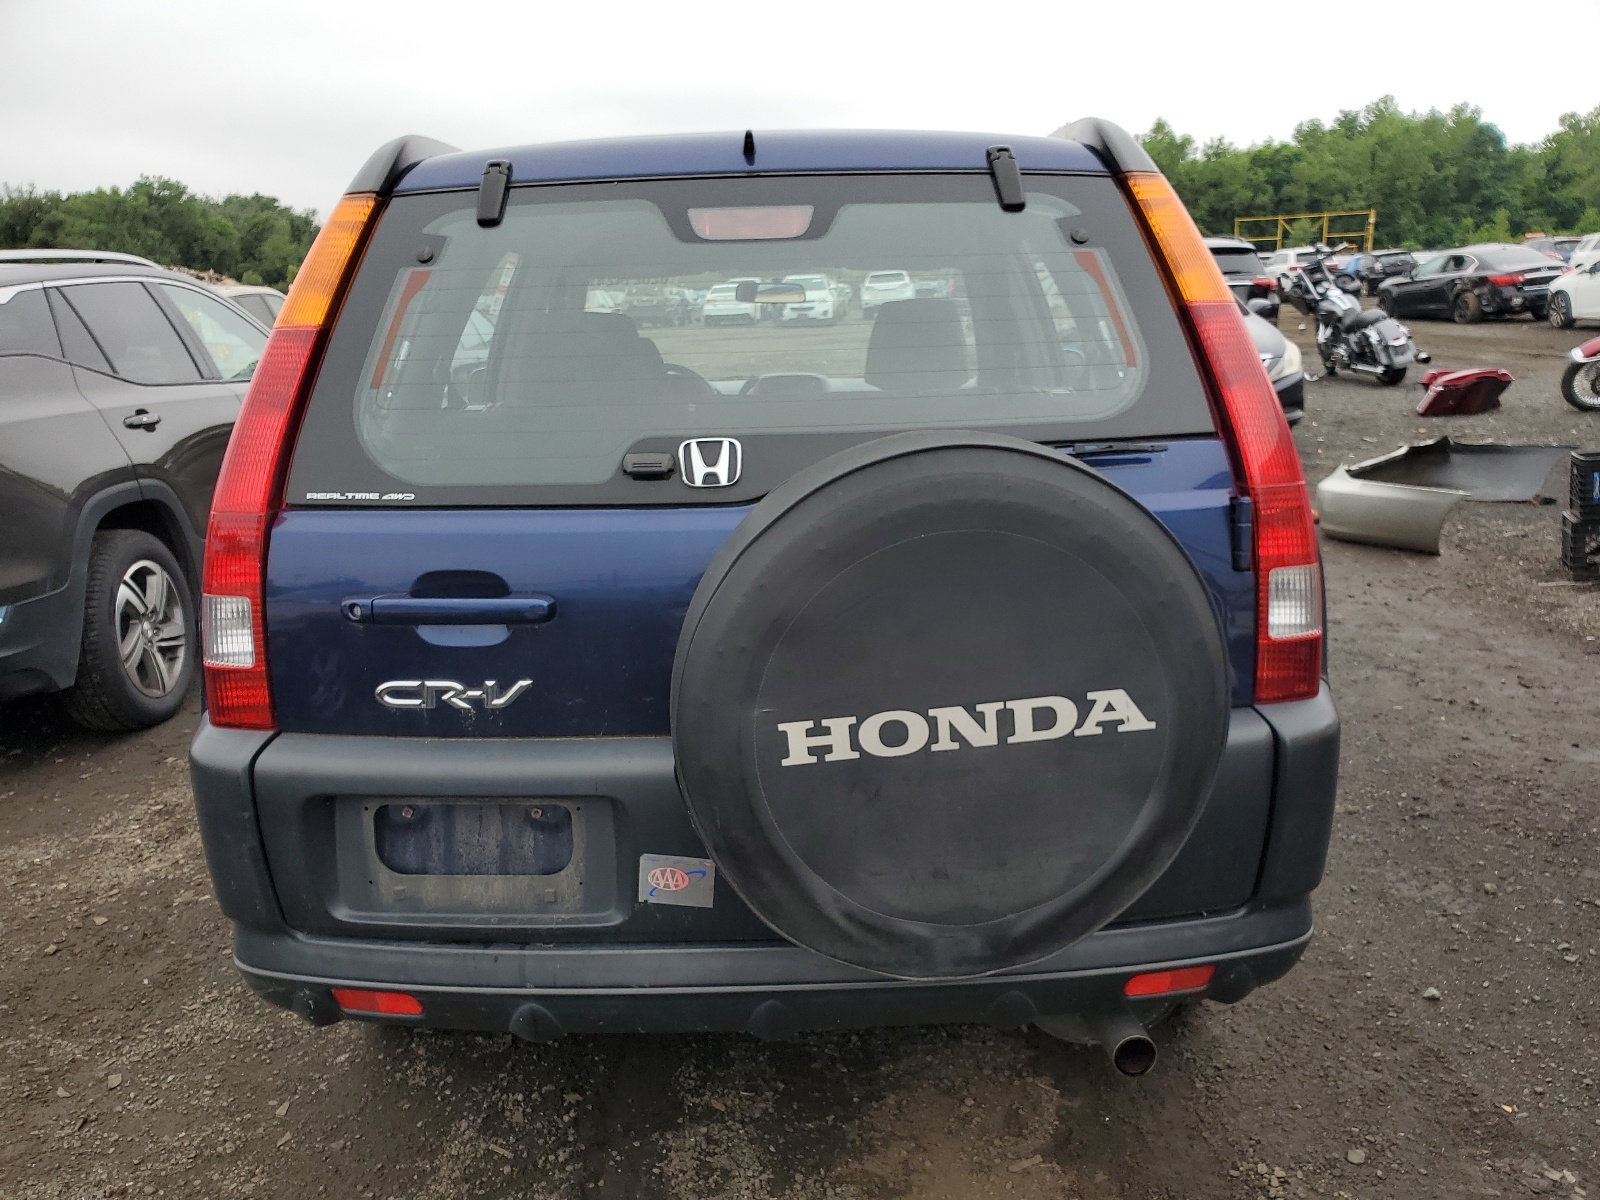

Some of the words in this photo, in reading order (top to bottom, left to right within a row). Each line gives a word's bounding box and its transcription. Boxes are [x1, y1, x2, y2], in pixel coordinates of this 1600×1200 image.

[381, 492, 415, 500] 4WD
[375, 680, 533, 708] CR-V
[777, 688, 1156, 767] HONDA
[650, 868, 687, 890] AAA
